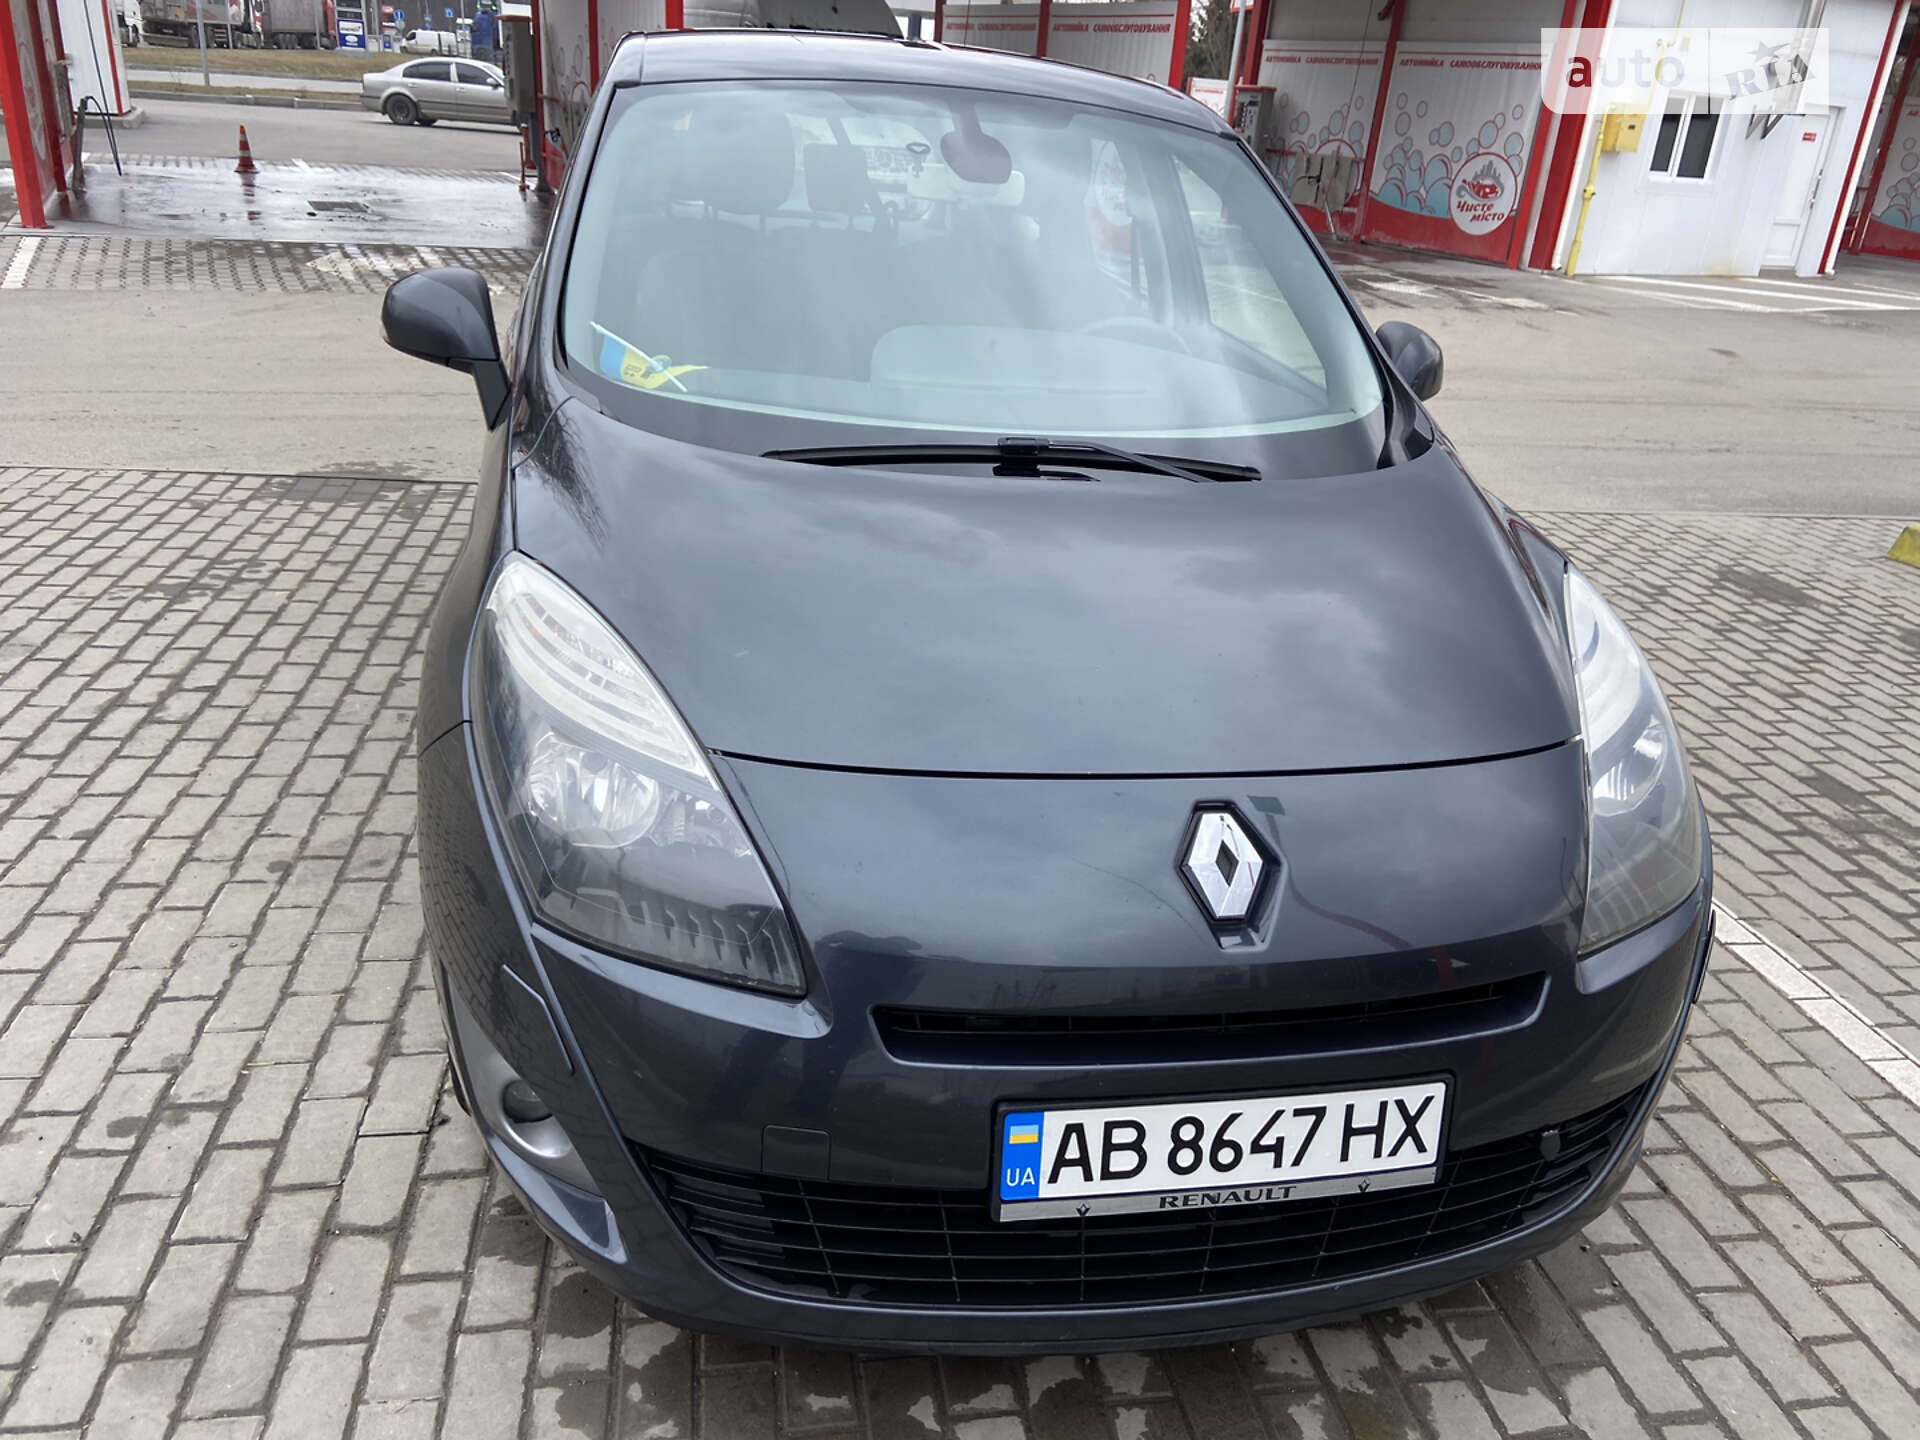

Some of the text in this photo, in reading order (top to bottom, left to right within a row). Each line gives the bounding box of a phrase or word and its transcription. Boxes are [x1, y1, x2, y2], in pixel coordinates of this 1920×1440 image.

[1457, 201, 1494, 212] Чисте
[1047, 1095, 1436, 1185] AB 8647 HX
[1006, 1167, 1036, 1187] UA
[1158, 1184, 1298, 1210] RENAULT
